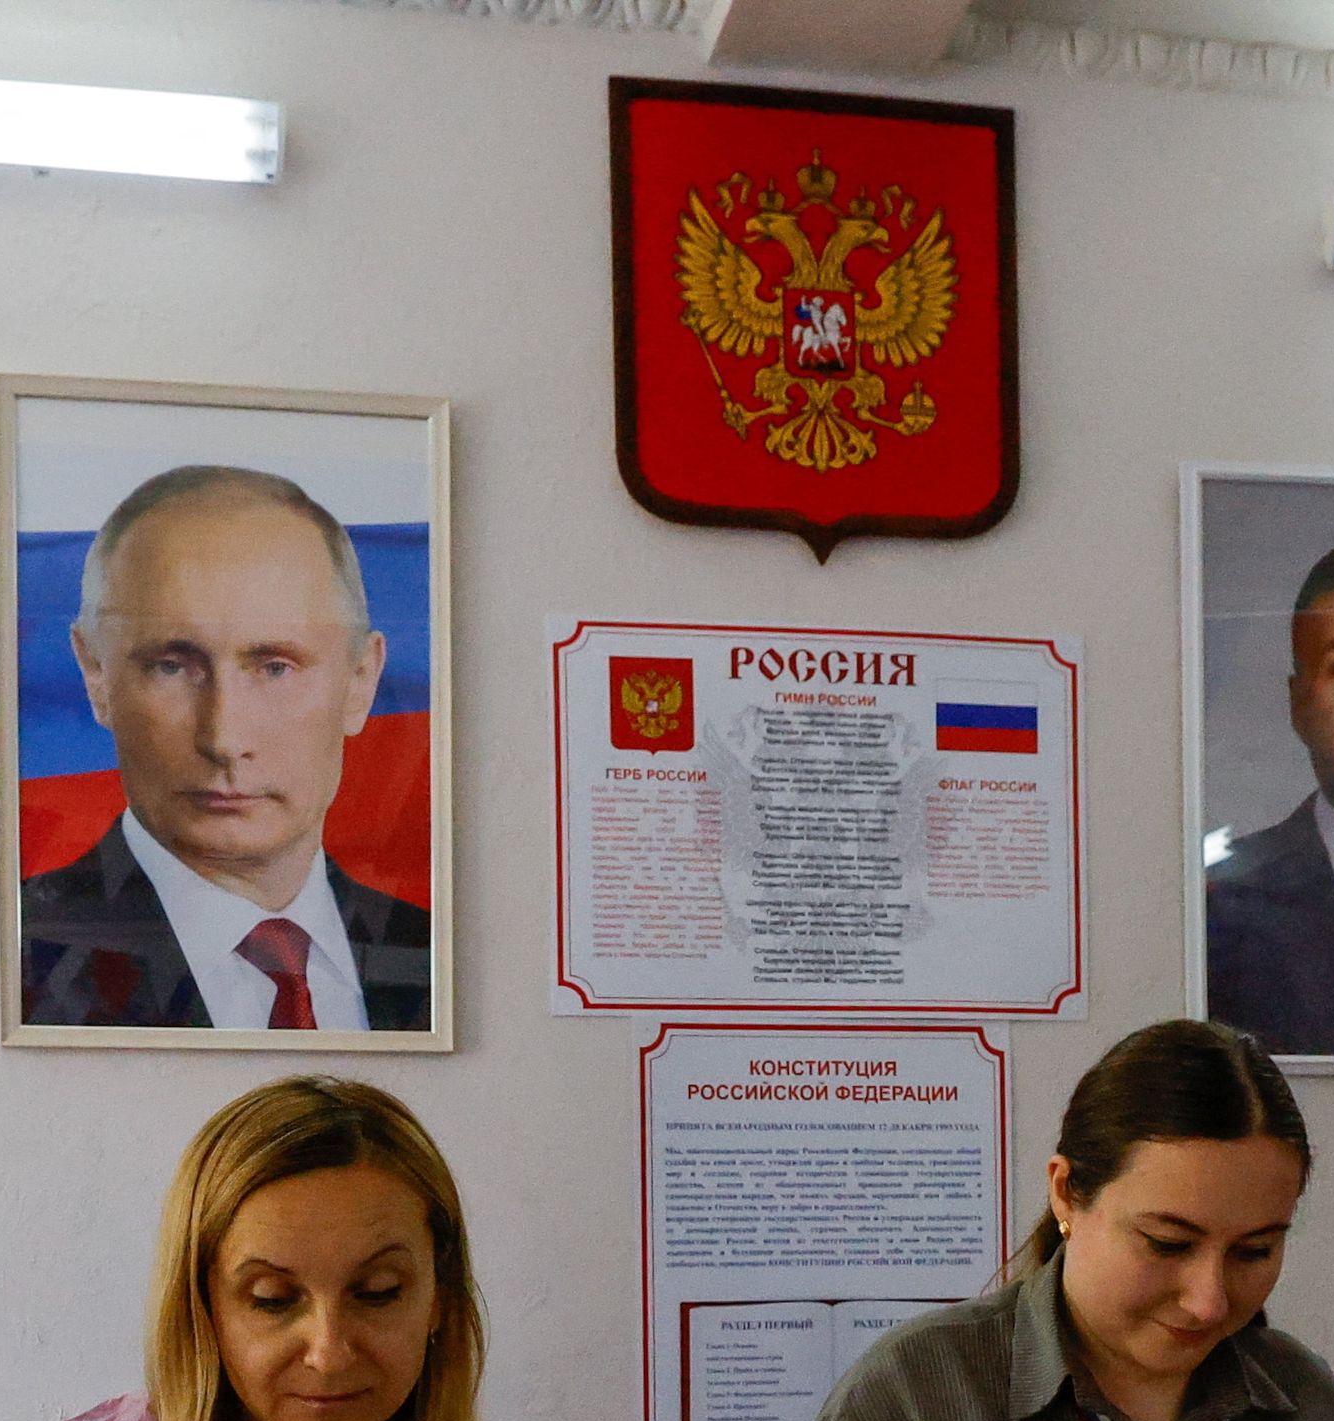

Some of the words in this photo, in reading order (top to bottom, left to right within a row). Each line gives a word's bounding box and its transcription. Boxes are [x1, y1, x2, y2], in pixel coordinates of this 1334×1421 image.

[728, 646, 917, 687] РОССИЯ
[775, 692, 815, 706] ГИМН
[818, 694, 877, 708] РОССИИ
[606, 768, 642, 781] ГЕРБ
[647, 769, 708, 783] РОССИИ
[939, 779, 975, 790] ФЛАГ
[980, 780, 1037, 792] РОССИИ
[749, 1060, 897, 1079] КОНСТИТУЦИЯ
[687, 1081, 829, 1102] РОССИЙСКОЙ
[835, 1084, 959, 1104] ФЕДЕРАЦИИ
